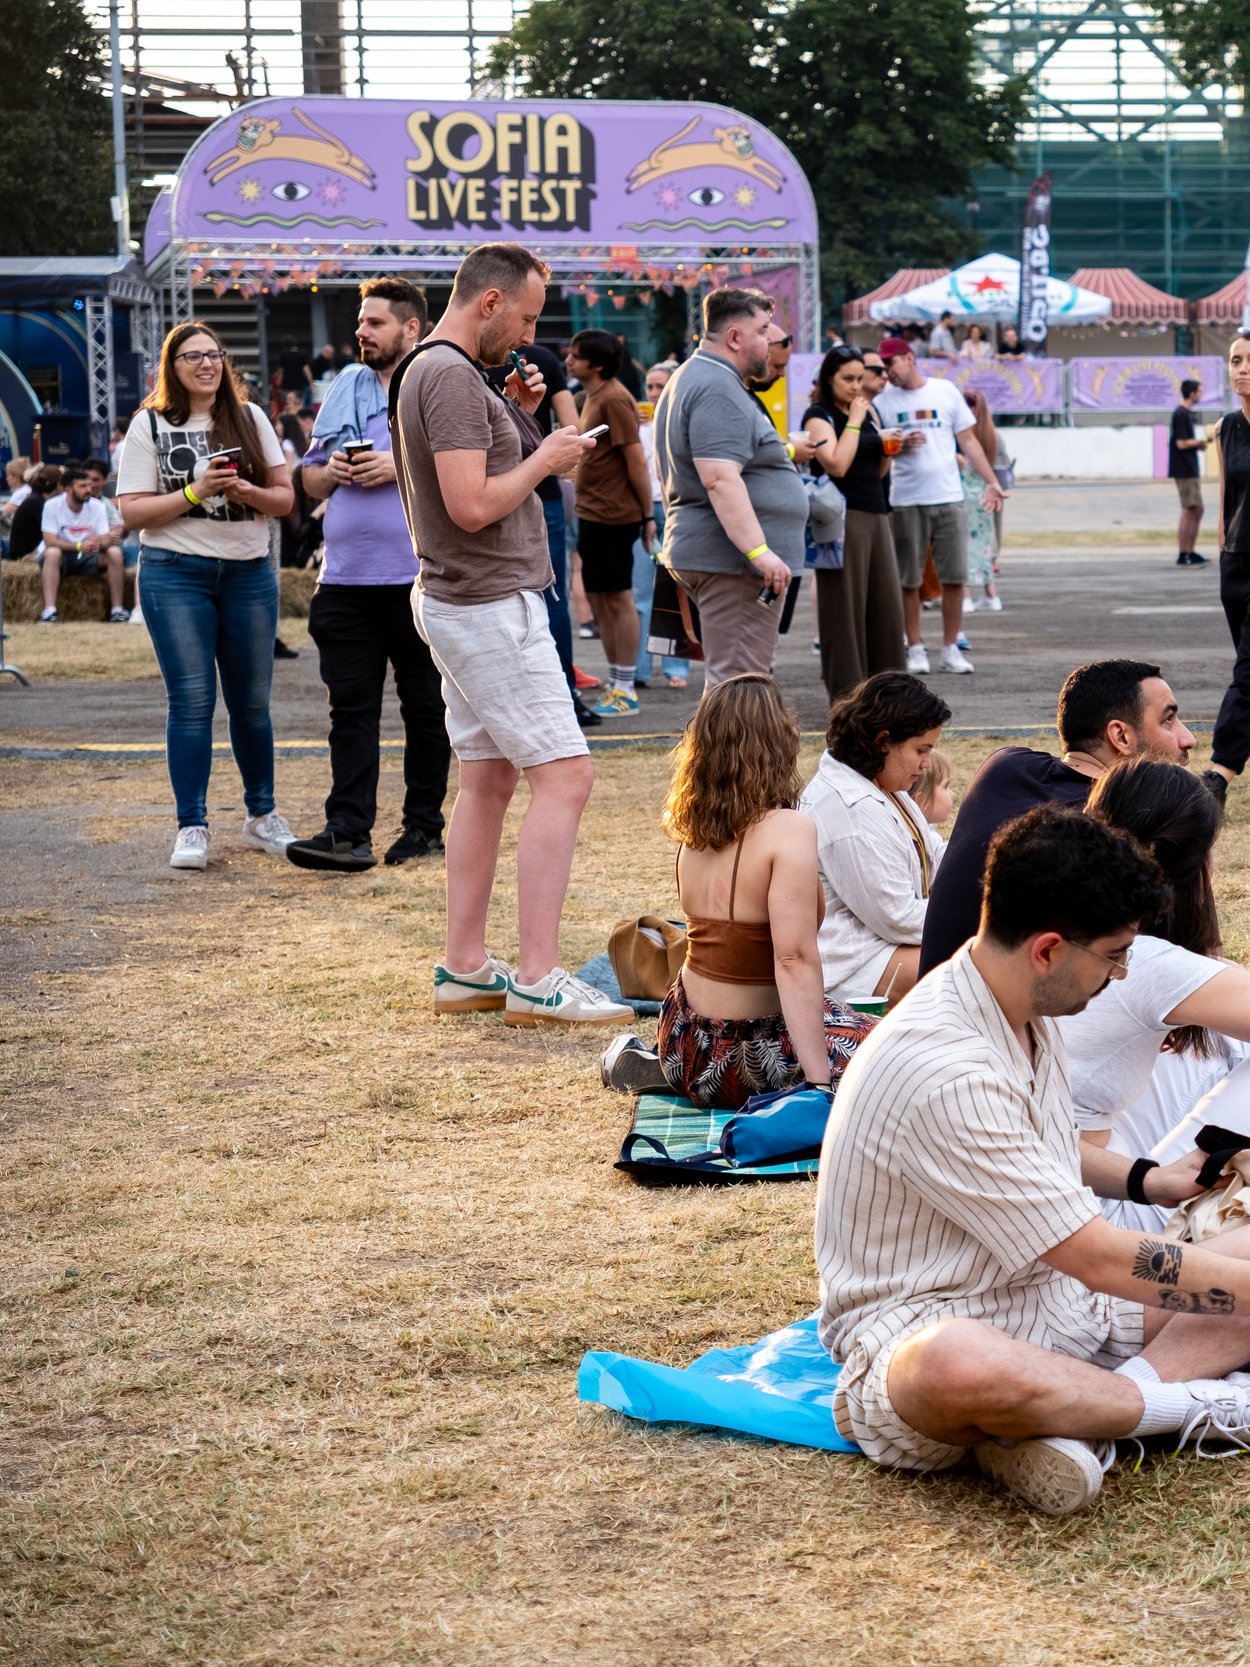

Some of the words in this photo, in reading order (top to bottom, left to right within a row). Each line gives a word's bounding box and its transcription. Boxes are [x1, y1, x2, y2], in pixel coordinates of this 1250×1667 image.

[406, 110, 582, 174] SOFIA
[406, 178, 487, 221] LIVE
[501, 179, 582, 222] FEST
